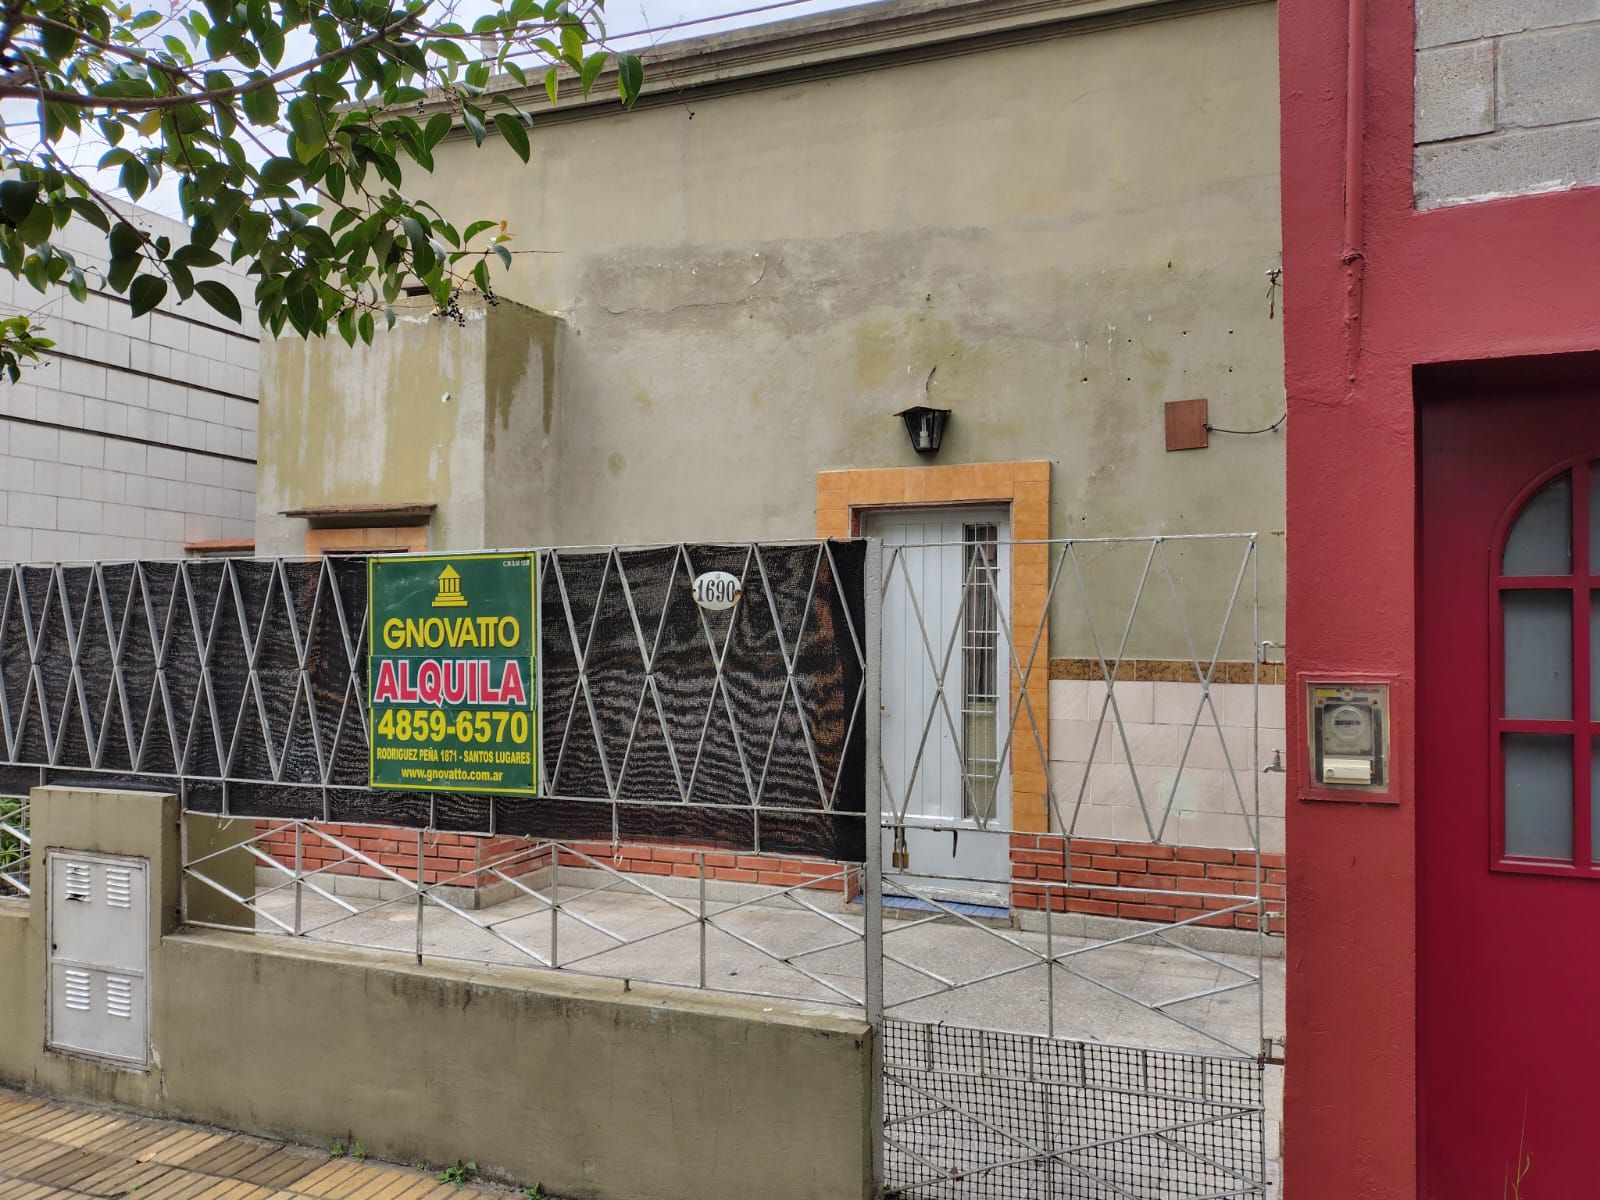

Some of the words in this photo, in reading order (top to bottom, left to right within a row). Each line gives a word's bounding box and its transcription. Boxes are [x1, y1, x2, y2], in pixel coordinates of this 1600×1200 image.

[697, 579, 736, 603] 1690
[383, 615, 520, 650] GNOVATTO
[373, 659, 527, 709] ALQUILA
[377, 709, 529, 744] 4859-6570
[376, 747, 418, 761] RODRIGUEZ
[420, 746, 439, 762] PEÑA
[440, 749, 457, 763] 1871
[463, 750, 494, 764] SANTOS
[495, 751, 531, 765] LUGARES
[401, 767, 503, 782] www.gnovatto.com.ar
